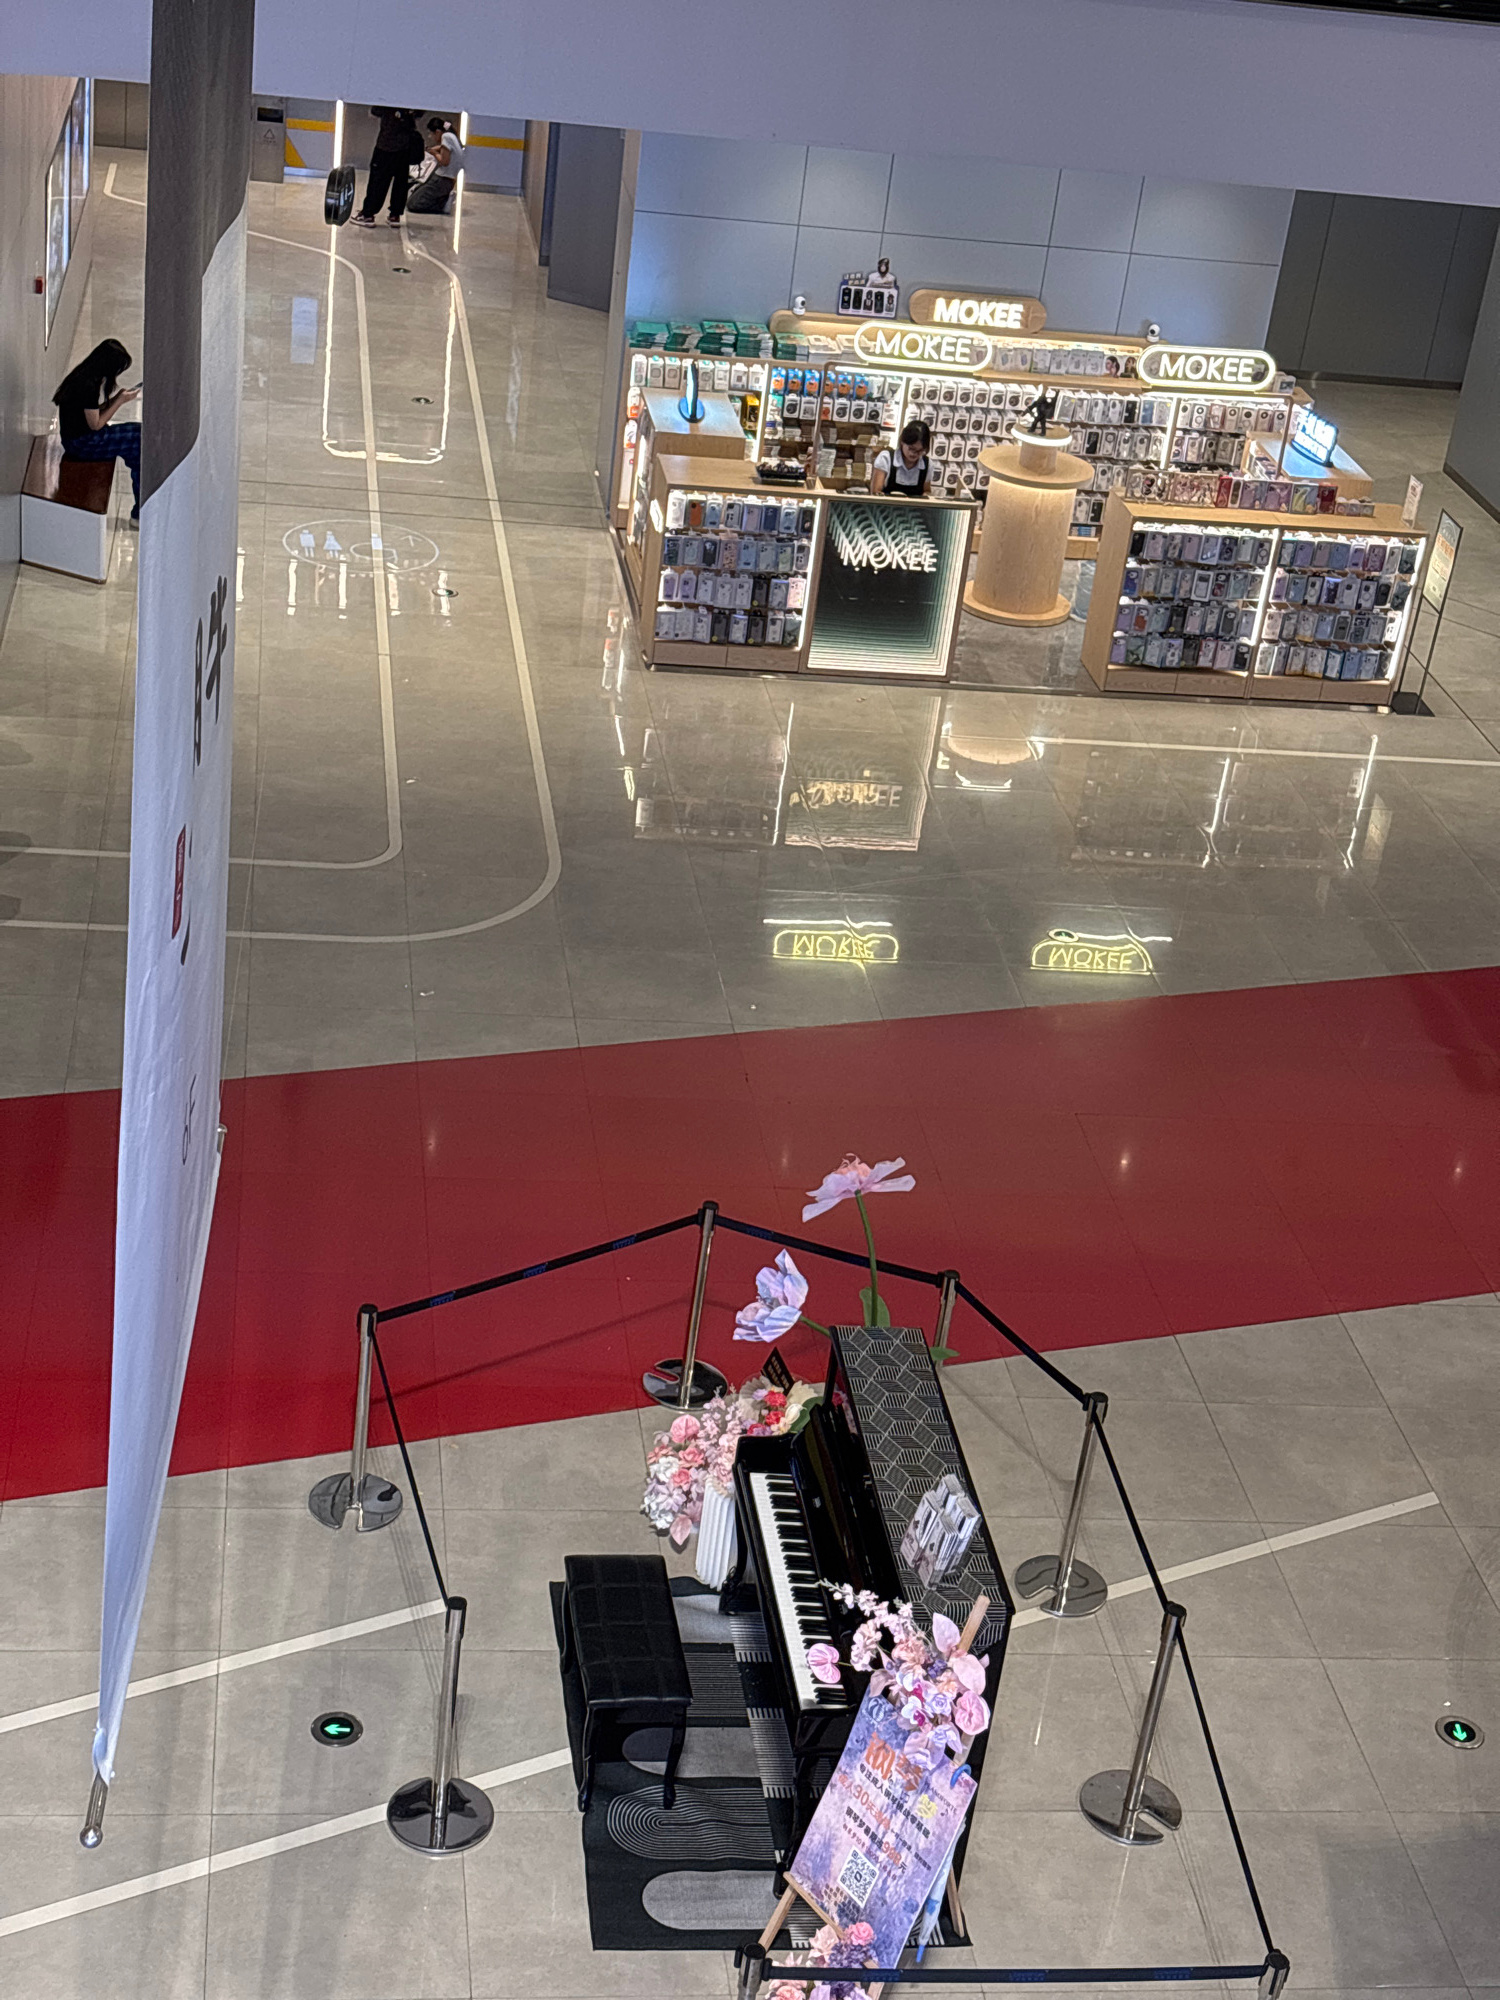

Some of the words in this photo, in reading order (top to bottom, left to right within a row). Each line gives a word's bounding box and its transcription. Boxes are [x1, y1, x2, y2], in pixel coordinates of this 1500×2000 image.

[933, 297, 1025, 329] MOKEE
[875, 329, 972, 363] MOKEE
[1158, 353, 1255, 383] MOKEE
[843, 538, 939, 573] MOKEE
